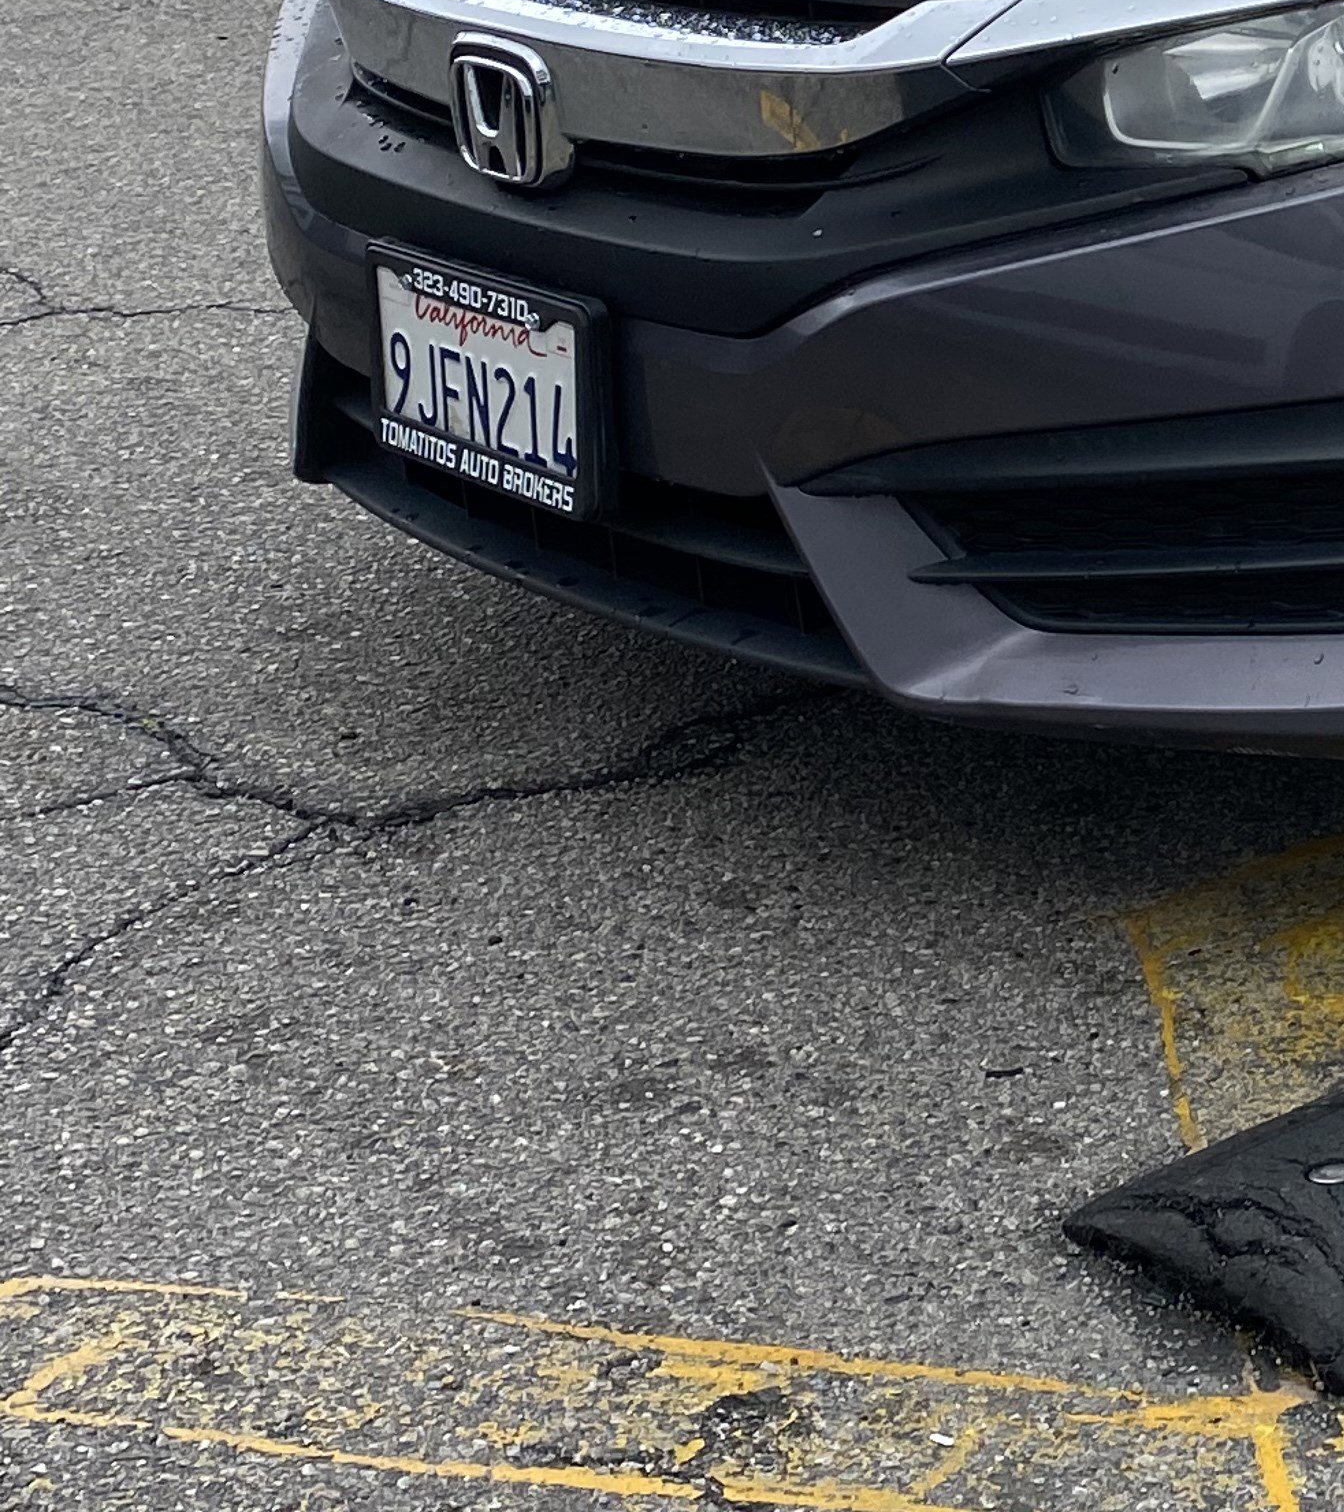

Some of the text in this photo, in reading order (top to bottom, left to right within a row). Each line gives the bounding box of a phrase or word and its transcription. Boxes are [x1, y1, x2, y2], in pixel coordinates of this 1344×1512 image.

[413, 267, 528, 322] 323-490-7310
[415, 292, 547, 357] California
[390, 332, 578, 477] 9JFN214
[381, 418, 575, 512] TOMATITOS AUTO BROKERS
